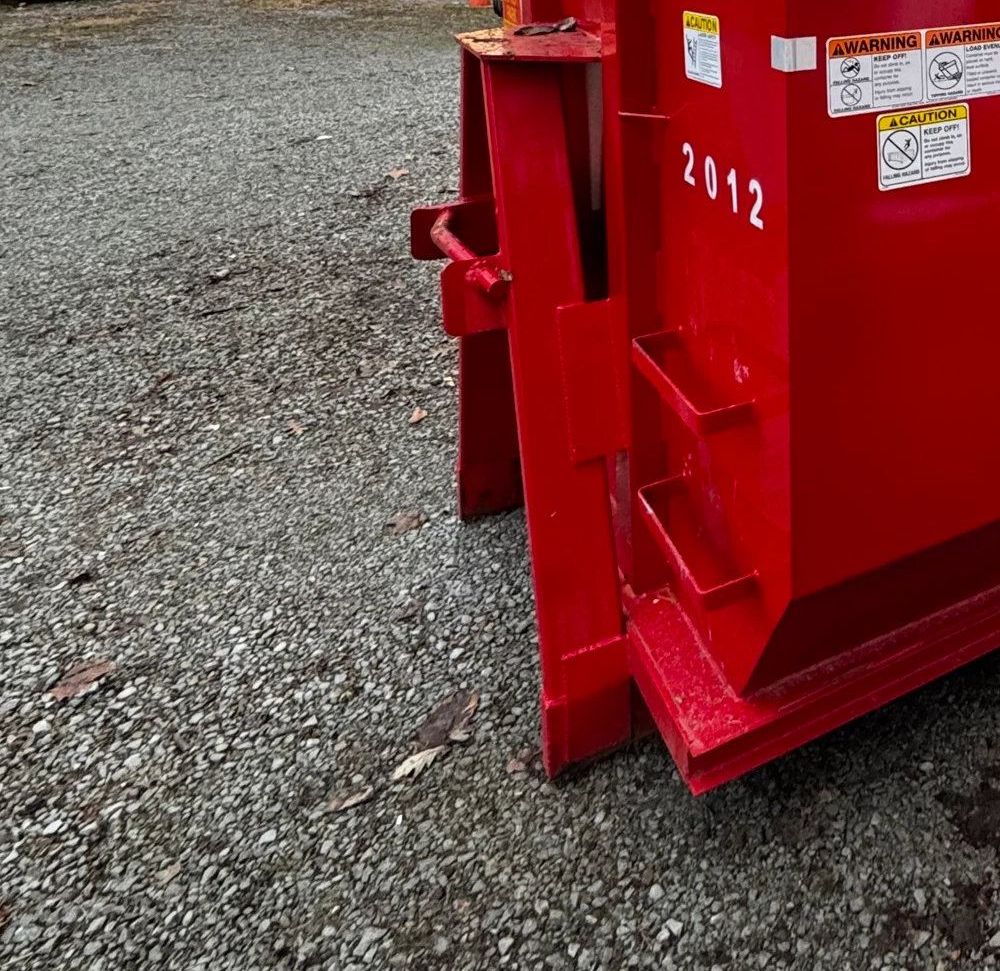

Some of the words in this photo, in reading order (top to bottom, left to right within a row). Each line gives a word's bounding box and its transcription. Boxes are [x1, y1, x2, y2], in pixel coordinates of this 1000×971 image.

[691, 16, 717, 32] CAUTION
[844, 35, 917, 54] WARNING
[900, 109, 956, 125] CAUTION
[924, 127, 942, 135] KEEP
[944, 124, 959, 132] OFF!
[682, 141, 764, 230] 2012
